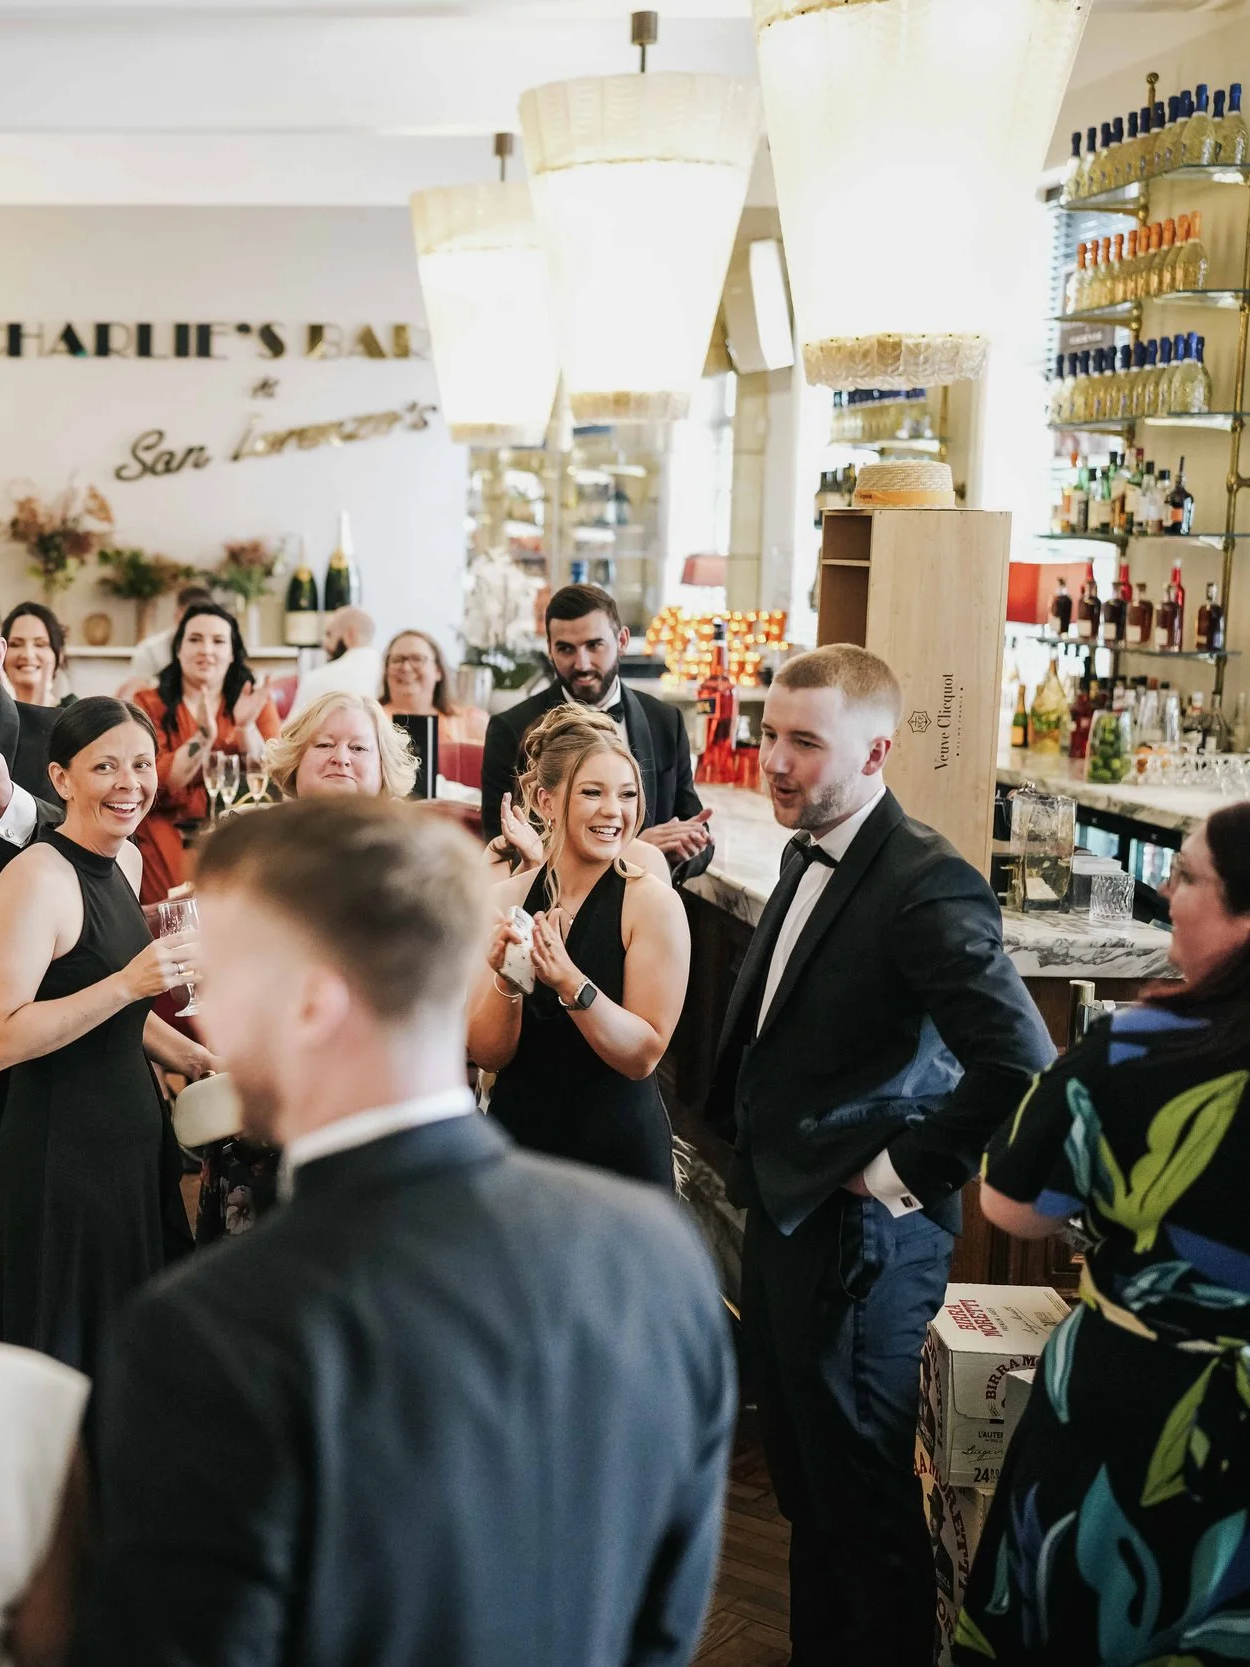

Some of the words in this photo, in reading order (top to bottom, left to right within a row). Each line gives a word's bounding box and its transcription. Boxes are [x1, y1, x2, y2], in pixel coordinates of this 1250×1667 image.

[304, 321, 432, 361] BAR
[115, 428, 213, 482] San
[937, 673, 955, 728] Clicquot
[934, 732, 951, 771] Veuve
[944, 1304, 978, 1331] BIRRA
[959, 1299, 1002, 1338] MORETTI
[986, 1359, 1020, 1400] BIRRA
[973, 1467, 990, 1483] 24
